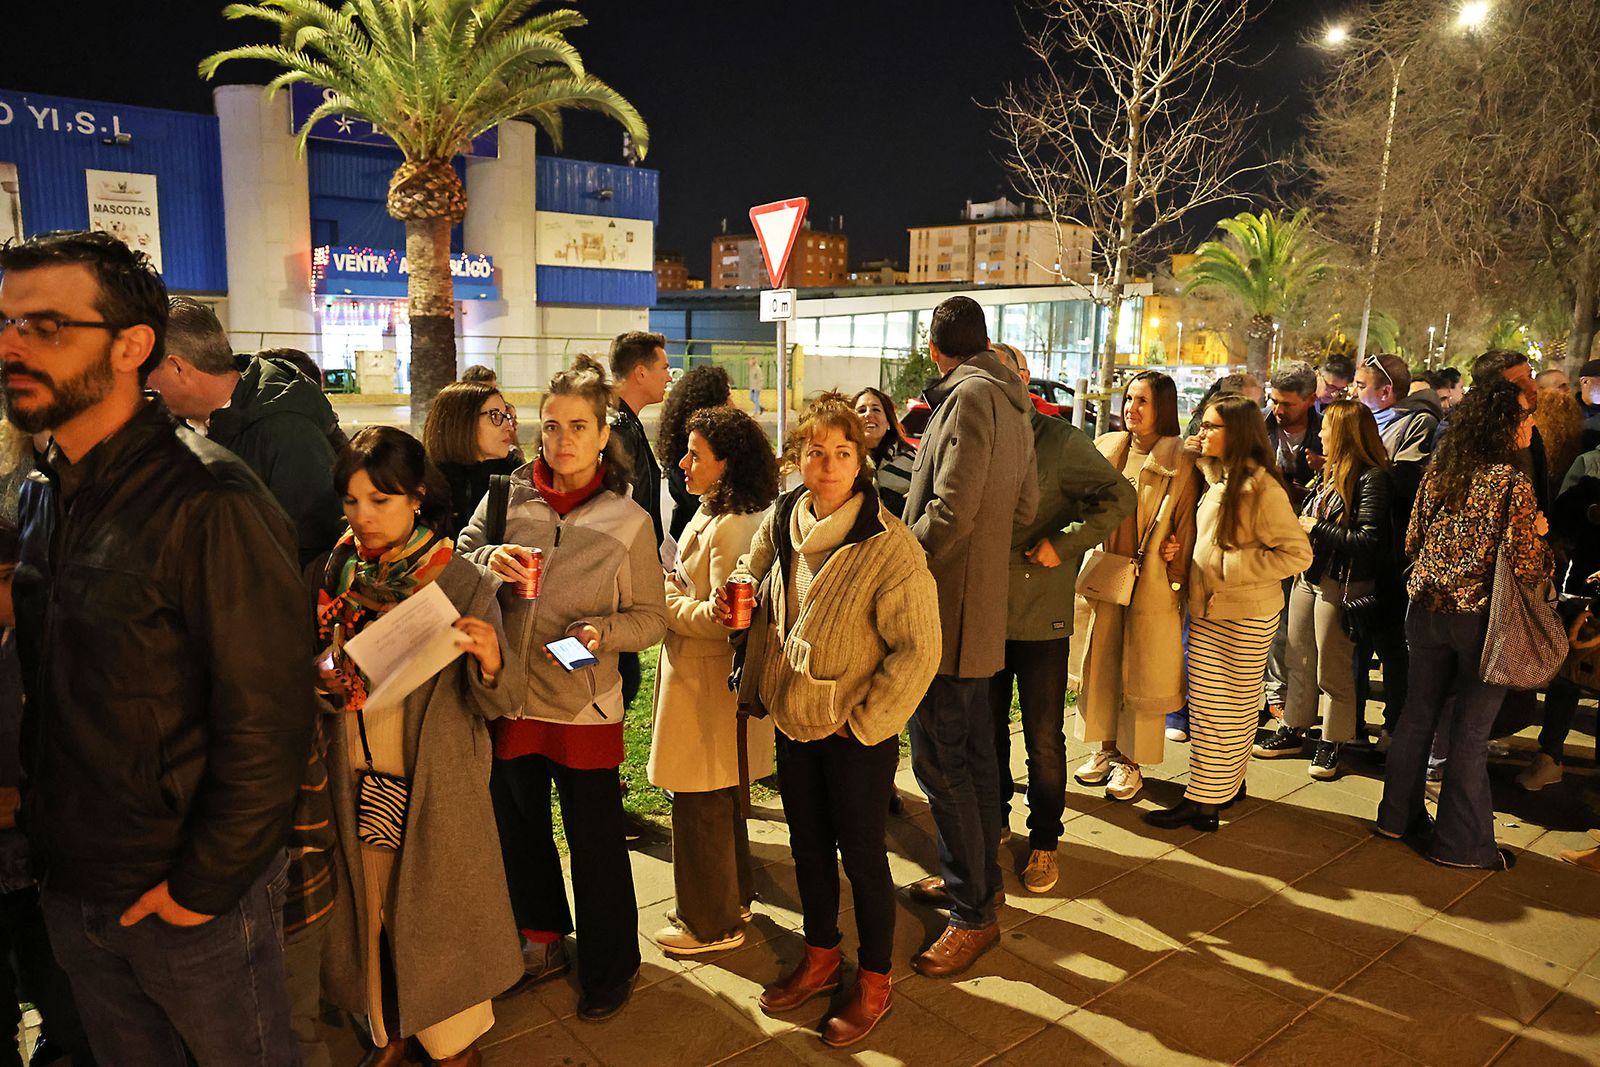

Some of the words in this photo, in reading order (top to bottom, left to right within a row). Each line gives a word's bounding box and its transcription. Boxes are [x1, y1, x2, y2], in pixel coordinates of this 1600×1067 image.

[93, 203, 151, 216] MASCOTAS
[333, 254, 388, 273] VENTA
[782, 302, 788, 312] m
